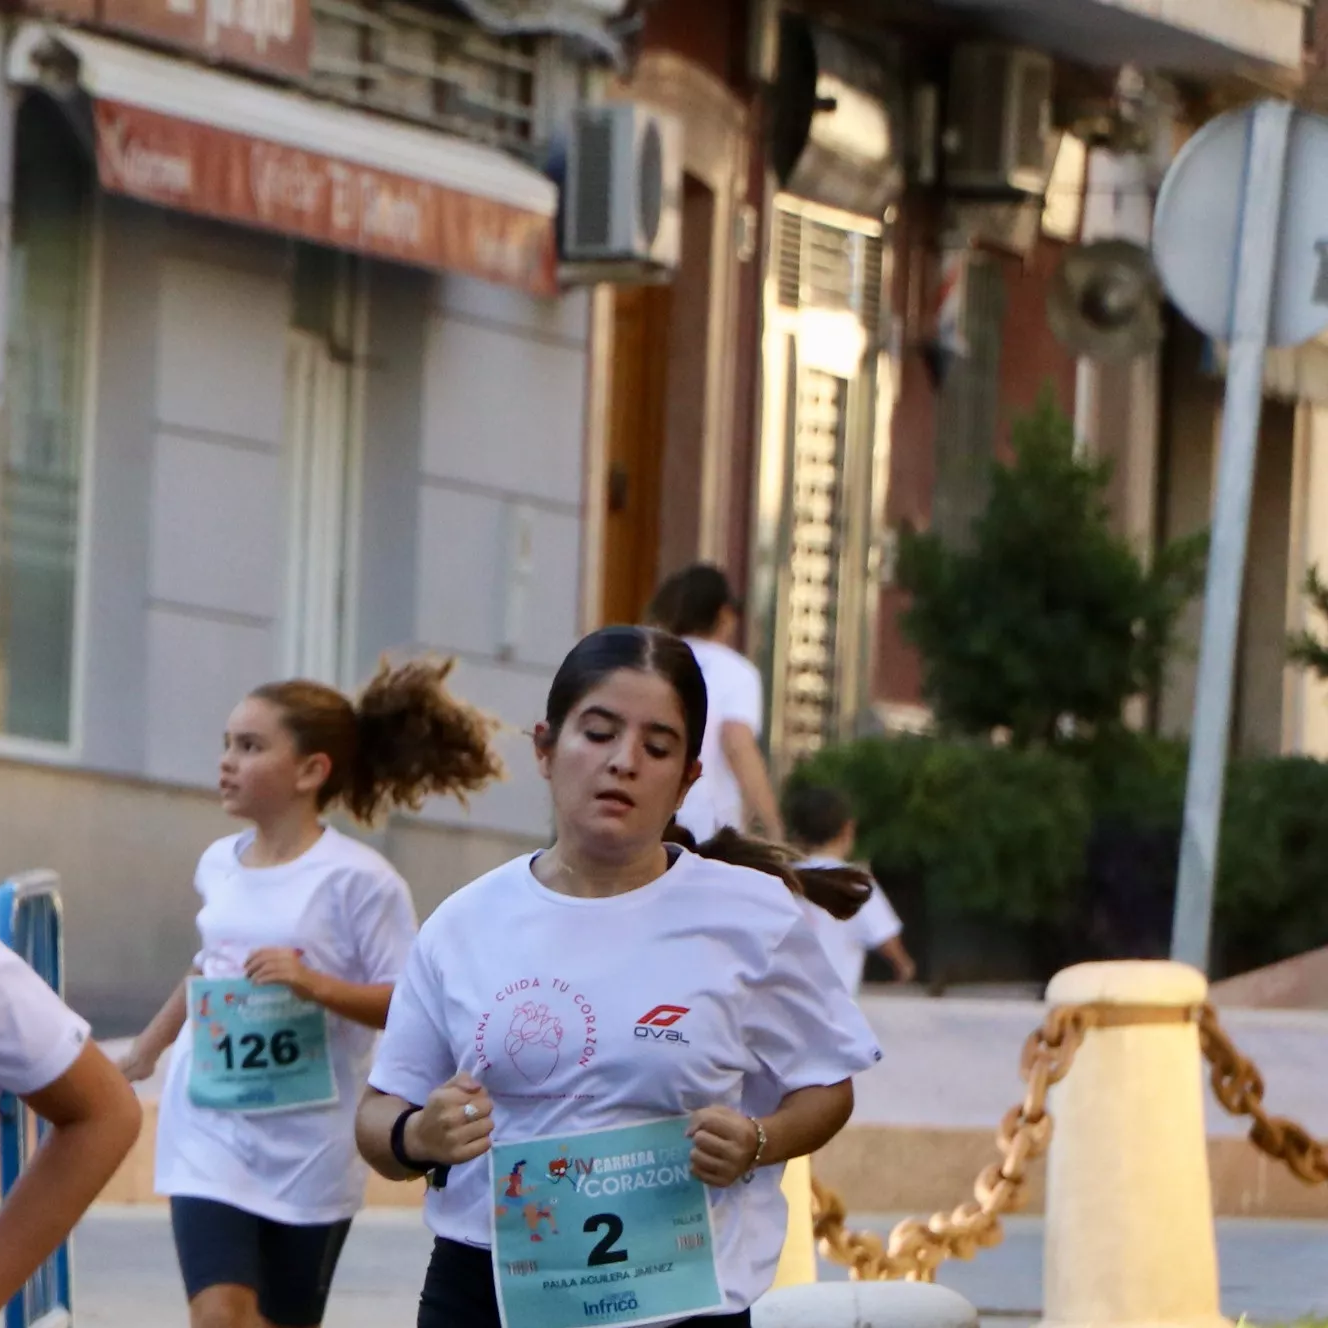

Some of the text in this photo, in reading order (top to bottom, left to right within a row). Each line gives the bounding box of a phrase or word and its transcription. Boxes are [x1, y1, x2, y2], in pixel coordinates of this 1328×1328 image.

[495, 977, 541, 1002] CUIDA
[552, 977, 571, 993] TU
[217, 1028, 301, 1070] 126
[574, 1156, 595, 1175] IV
[593, 1150, 656, 1174] CARRERA
[582, 1212, 629, 1267] 2
[542, 1277, 577, 1290] PAULA
[580, 1270, 631, 1286] AGUILERA
